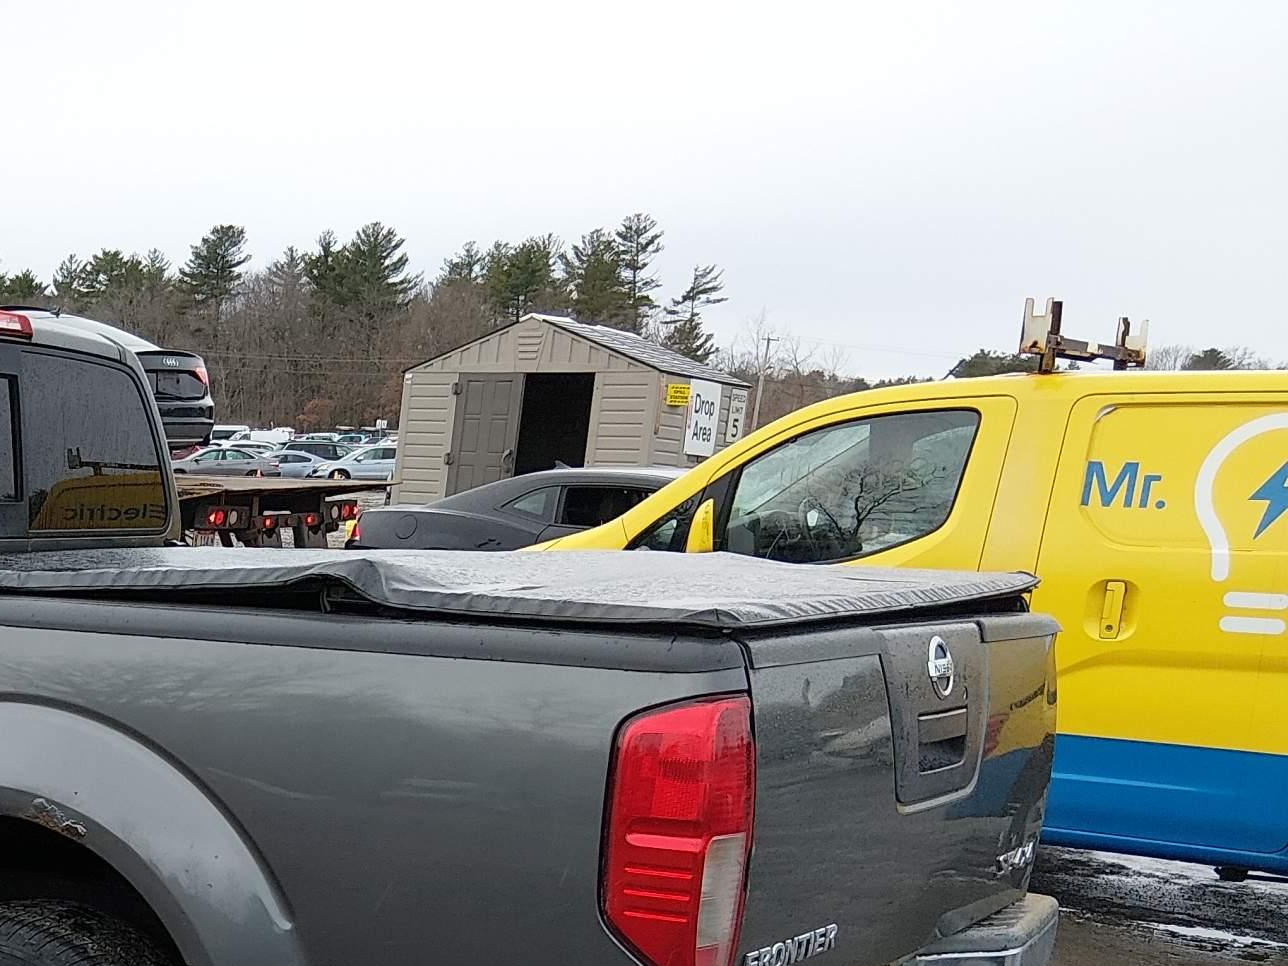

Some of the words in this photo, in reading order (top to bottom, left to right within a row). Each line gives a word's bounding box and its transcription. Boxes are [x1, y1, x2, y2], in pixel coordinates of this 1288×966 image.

[694, 393, 715, 420] Drop
[692, 420, 712, 442] Area
[731, 418, 739, 437] 5
[1080, 460, 1166, 509] Mr.
